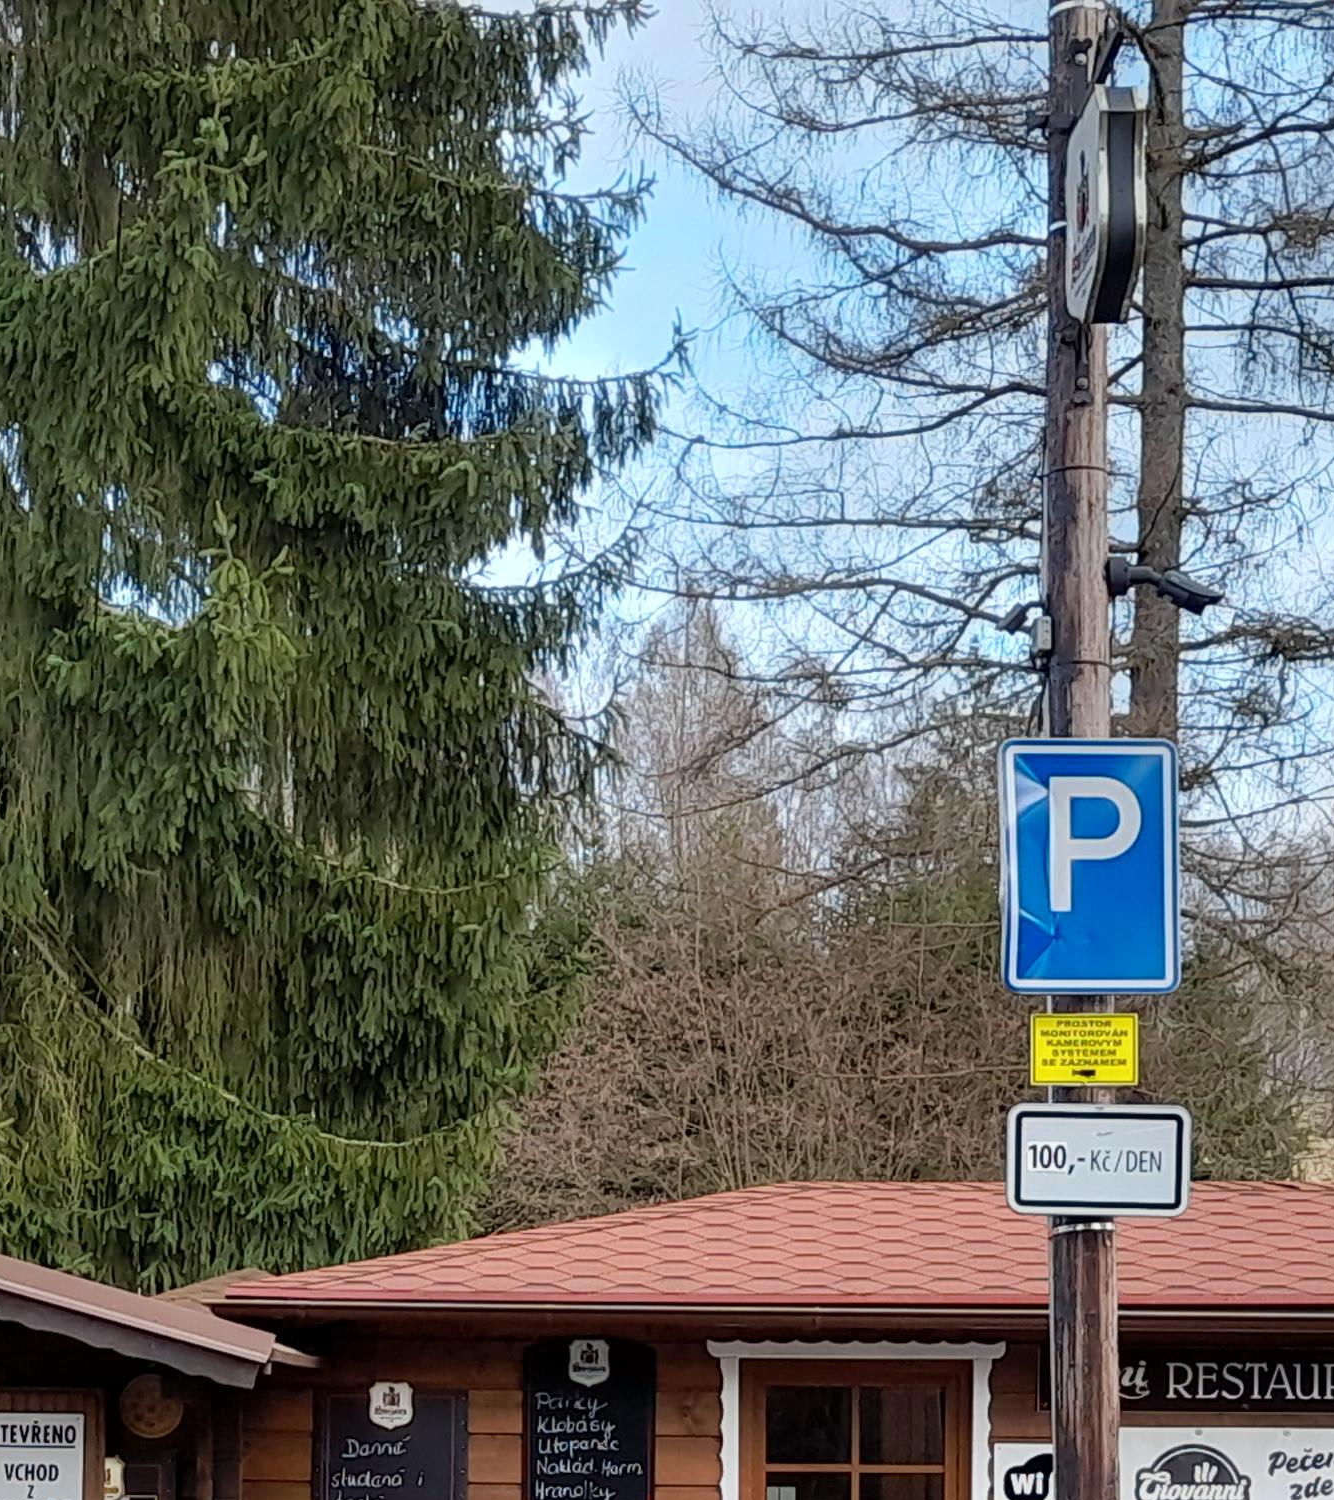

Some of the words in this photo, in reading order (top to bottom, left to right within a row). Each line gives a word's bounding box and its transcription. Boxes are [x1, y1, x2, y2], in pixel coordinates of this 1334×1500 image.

[1049, 776, 1141, 912] P
[4, 1463, 59, 1482] VCHOD
[27, 1485, 35, 1499] Z
